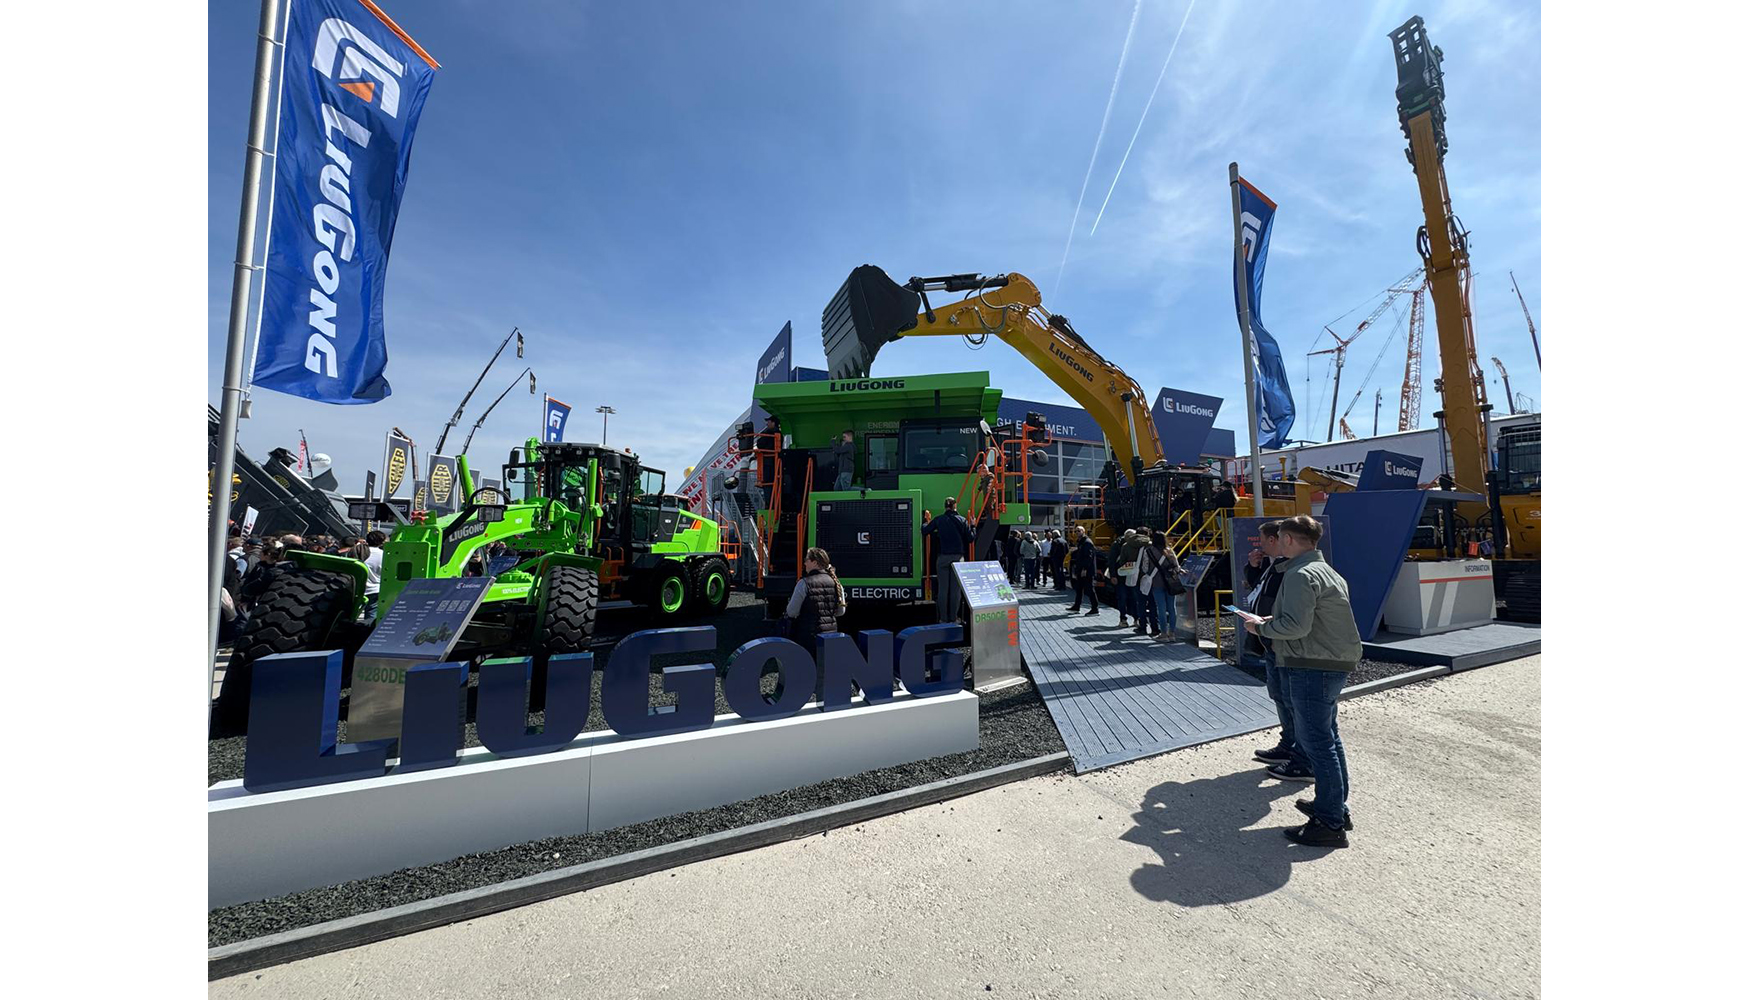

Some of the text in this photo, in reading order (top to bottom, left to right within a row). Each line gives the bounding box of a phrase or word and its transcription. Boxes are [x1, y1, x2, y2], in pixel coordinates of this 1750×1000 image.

[960, 427, 978, 435] NEW
[851, 587, 910, 599] ELECTRIC
[1007, 609, 1018, 646] NEW
